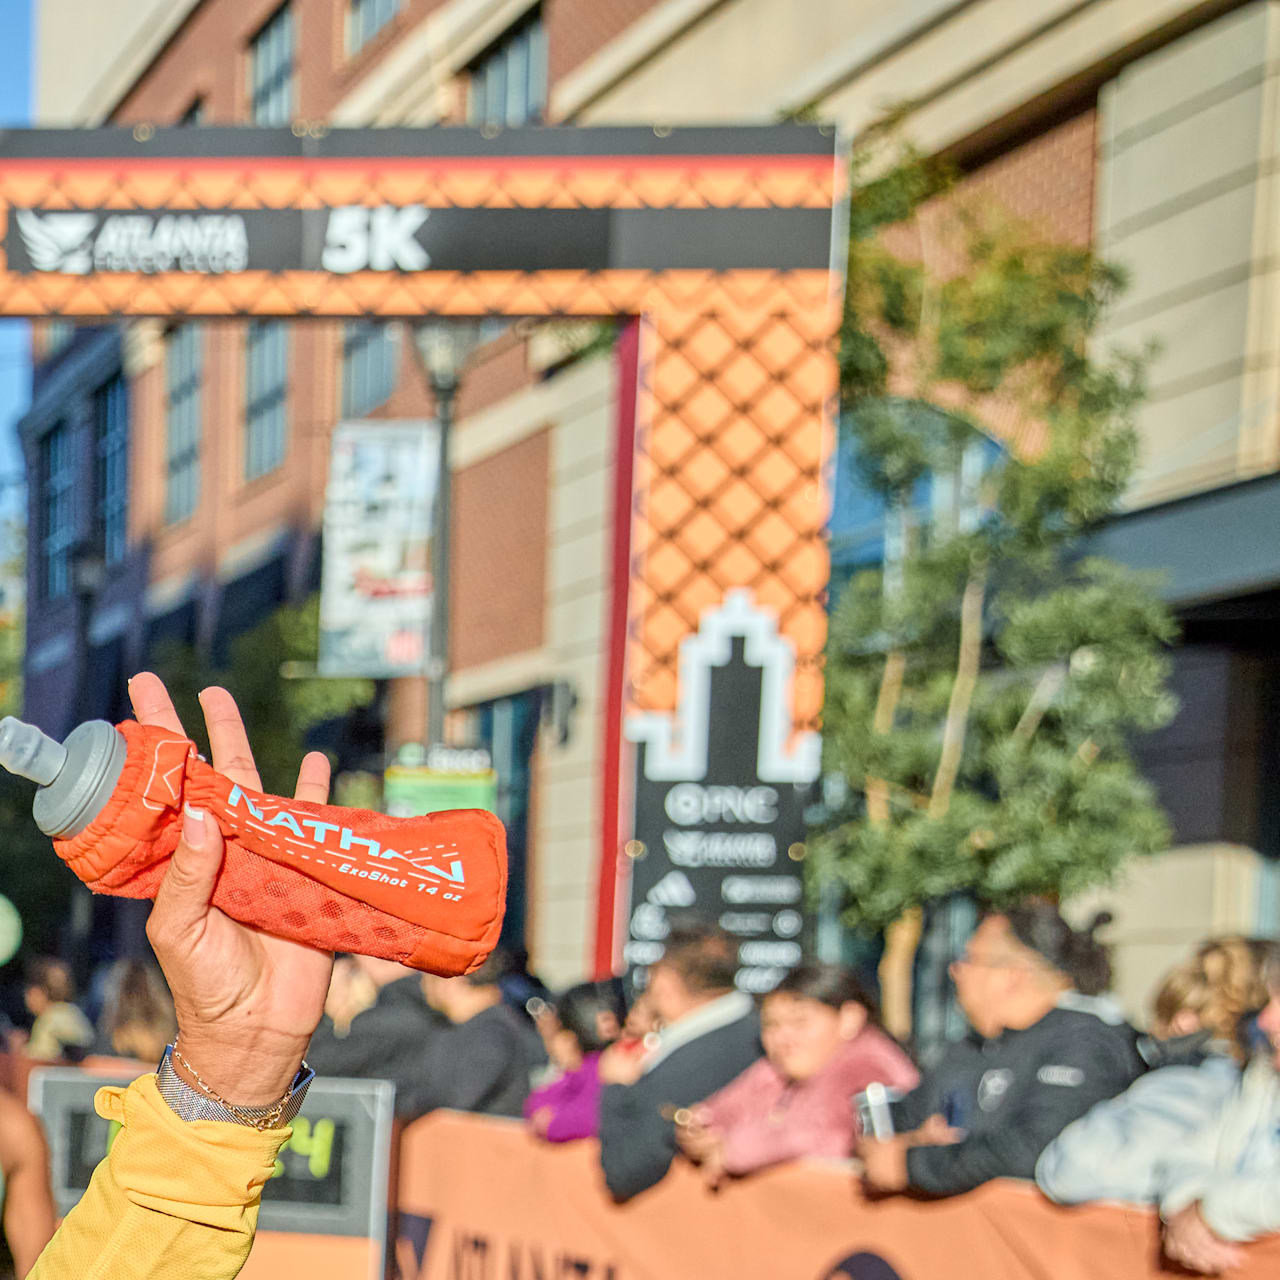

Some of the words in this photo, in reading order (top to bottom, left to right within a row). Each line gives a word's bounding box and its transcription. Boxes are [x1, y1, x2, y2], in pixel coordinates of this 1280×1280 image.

[95, 214, 248, 256] ATLANTA
[321, 204, 432, 273] 5K
[703, 785, 779, 824] PNC
[228, 784, 465, 884] NATHAN
[338, 863, 408, 888] ExoShot
[417, 883, 439, 896] 14
[443, 892, 463, 902] oz
